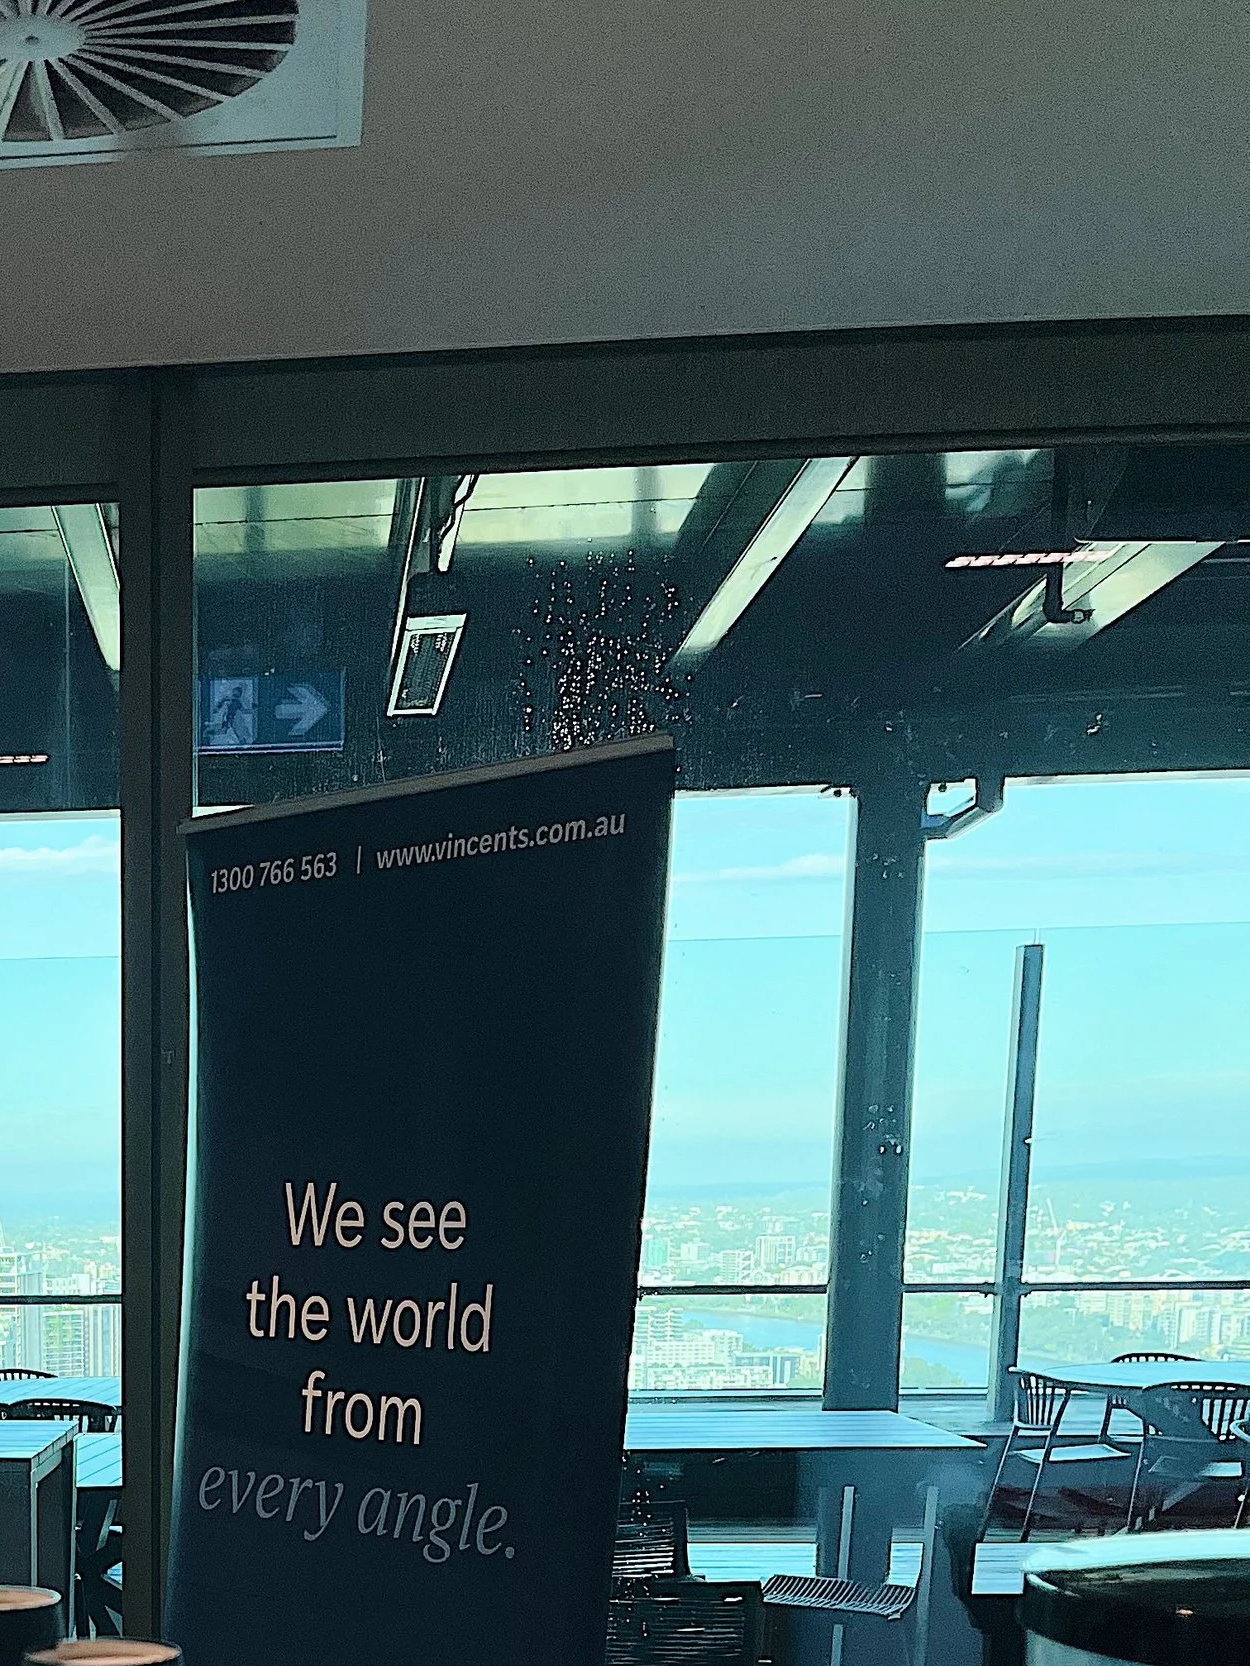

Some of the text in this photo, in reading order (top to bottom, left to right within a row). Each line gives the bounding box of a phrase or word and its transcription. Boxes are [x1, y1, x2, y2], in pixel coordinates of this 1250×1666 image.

[210, 813, 626, 894] 1300 766 563 www.vincents.com.au
[285, 1181, 467, 1249] We see
[246, 1275, 494, 1352] the world
[301, 1370, 422, 1444] from
[198, 1465, 516, 1563] every angle.
